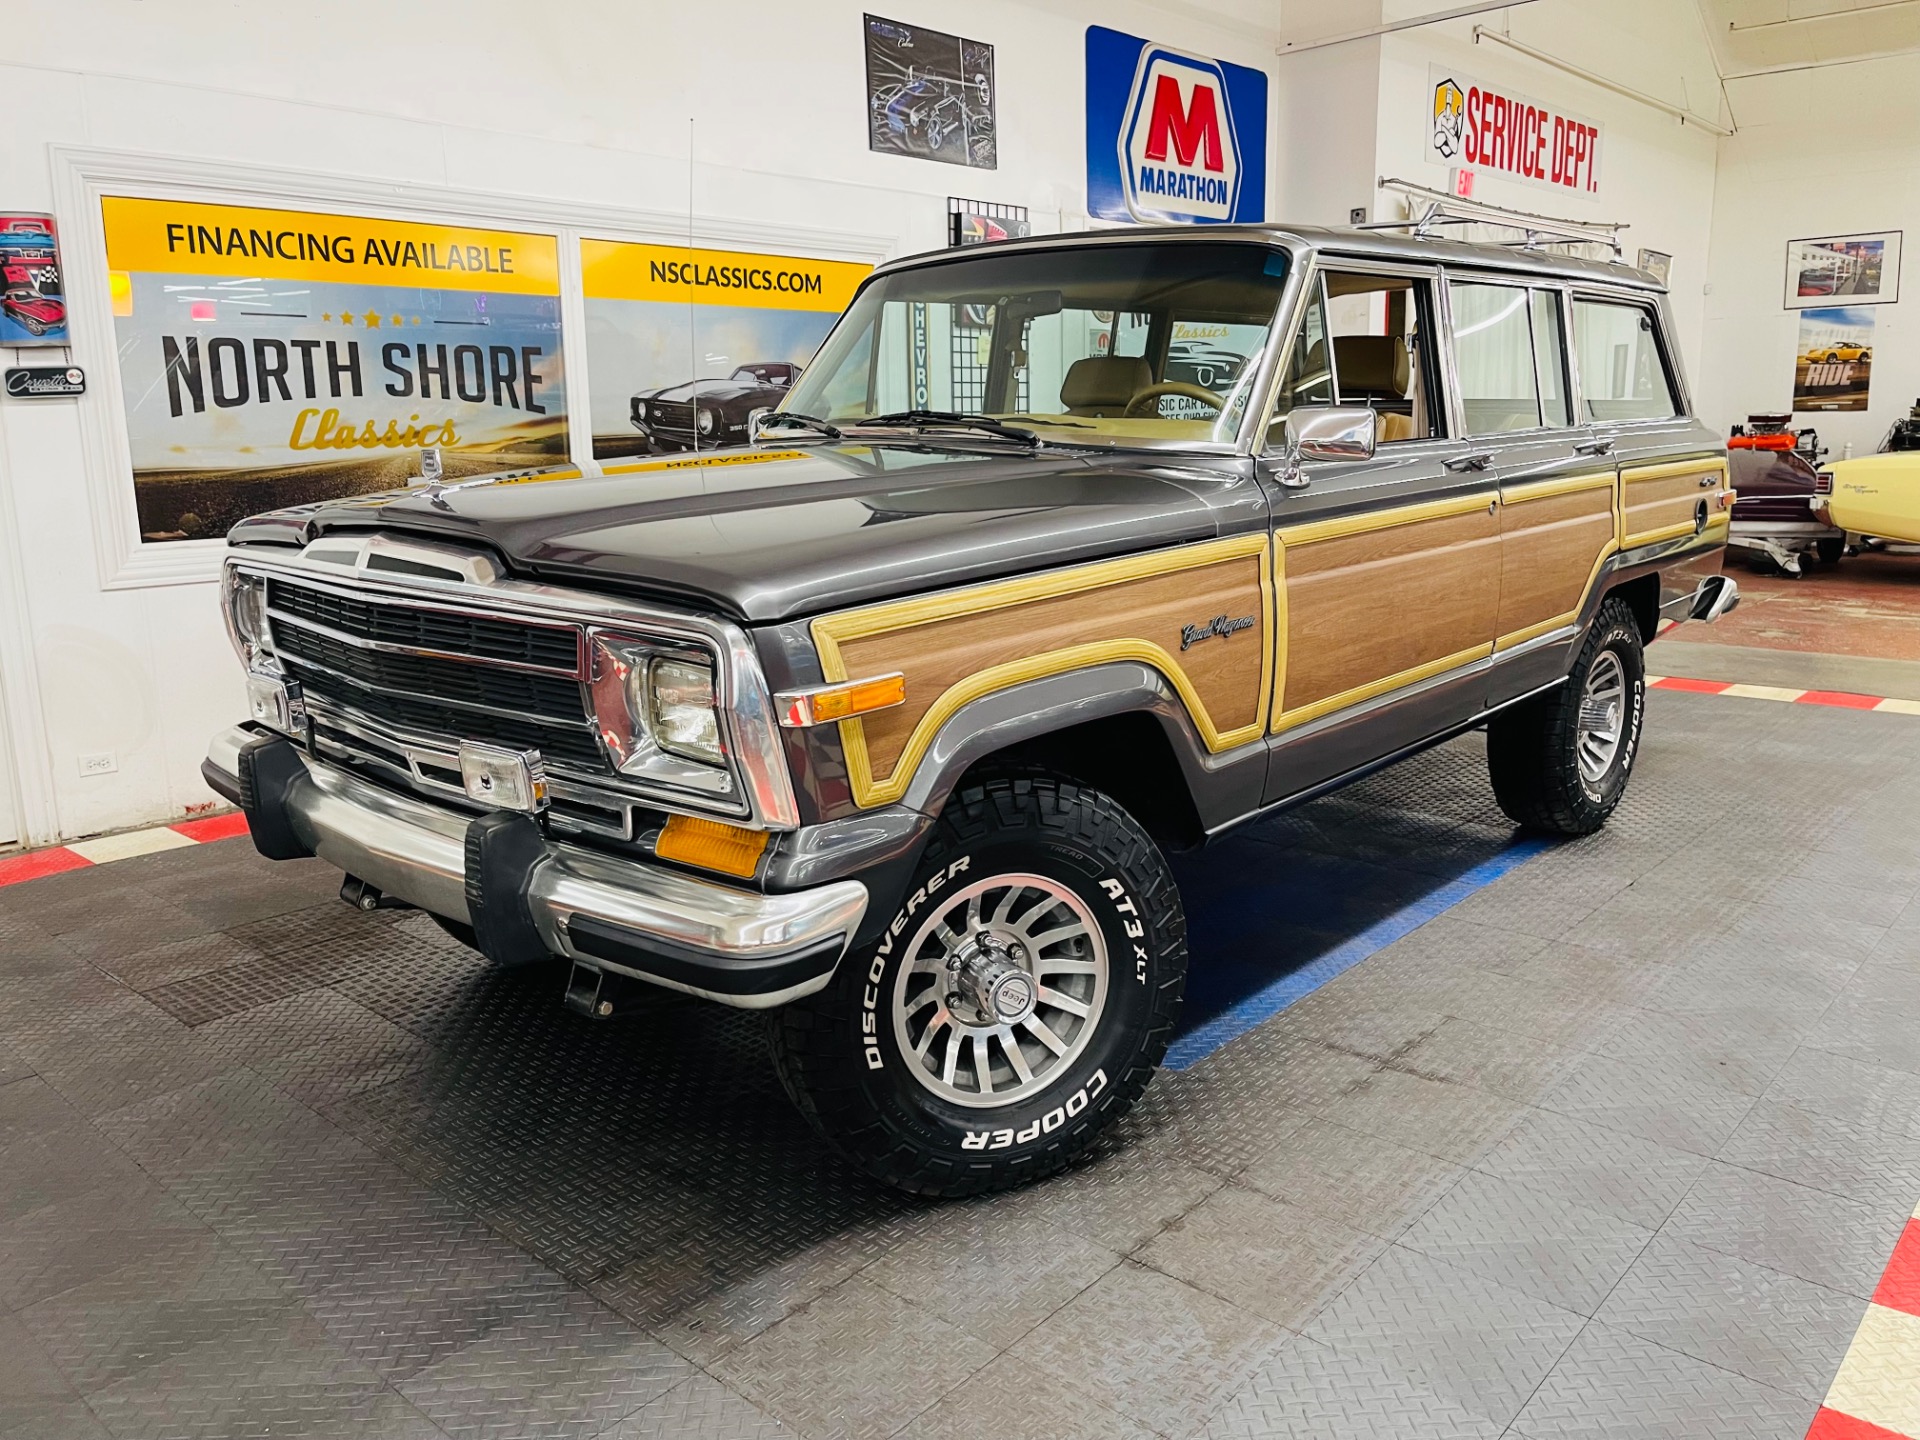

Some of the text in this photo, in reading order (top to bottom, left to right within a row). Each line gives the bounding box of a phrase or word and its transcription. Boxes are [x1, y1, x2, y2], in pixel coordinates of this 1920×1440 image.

[1144, 74, 1224, 173] M
[1464, 86, 1598, 193] SERVICE DEPT.
[1139, 166, 1228, 205] MARATHON
[166, 223, 514, 274] FINANCING AVAILABLE
[650, 260, 822, 294] NSCLASSICS.COM
[1173, 325, 1229, 339] lassics
[162, 335, 546, 418] NORTH SHORE
[1804, 363, 1854, 387] RIDE
[288, 408, 462, 451] Classics
[1181, 623, 1213, 650] Grand
[1622, 680, 1641, 770] COOPER
[1098, 878, 1148, 985] AT3 XLT
[862, 855, 970, 1070] DISCOVERER
[1002, 990, 1025, 1005] Jeep
[961, 1068, 1108, 1150] COOPER
